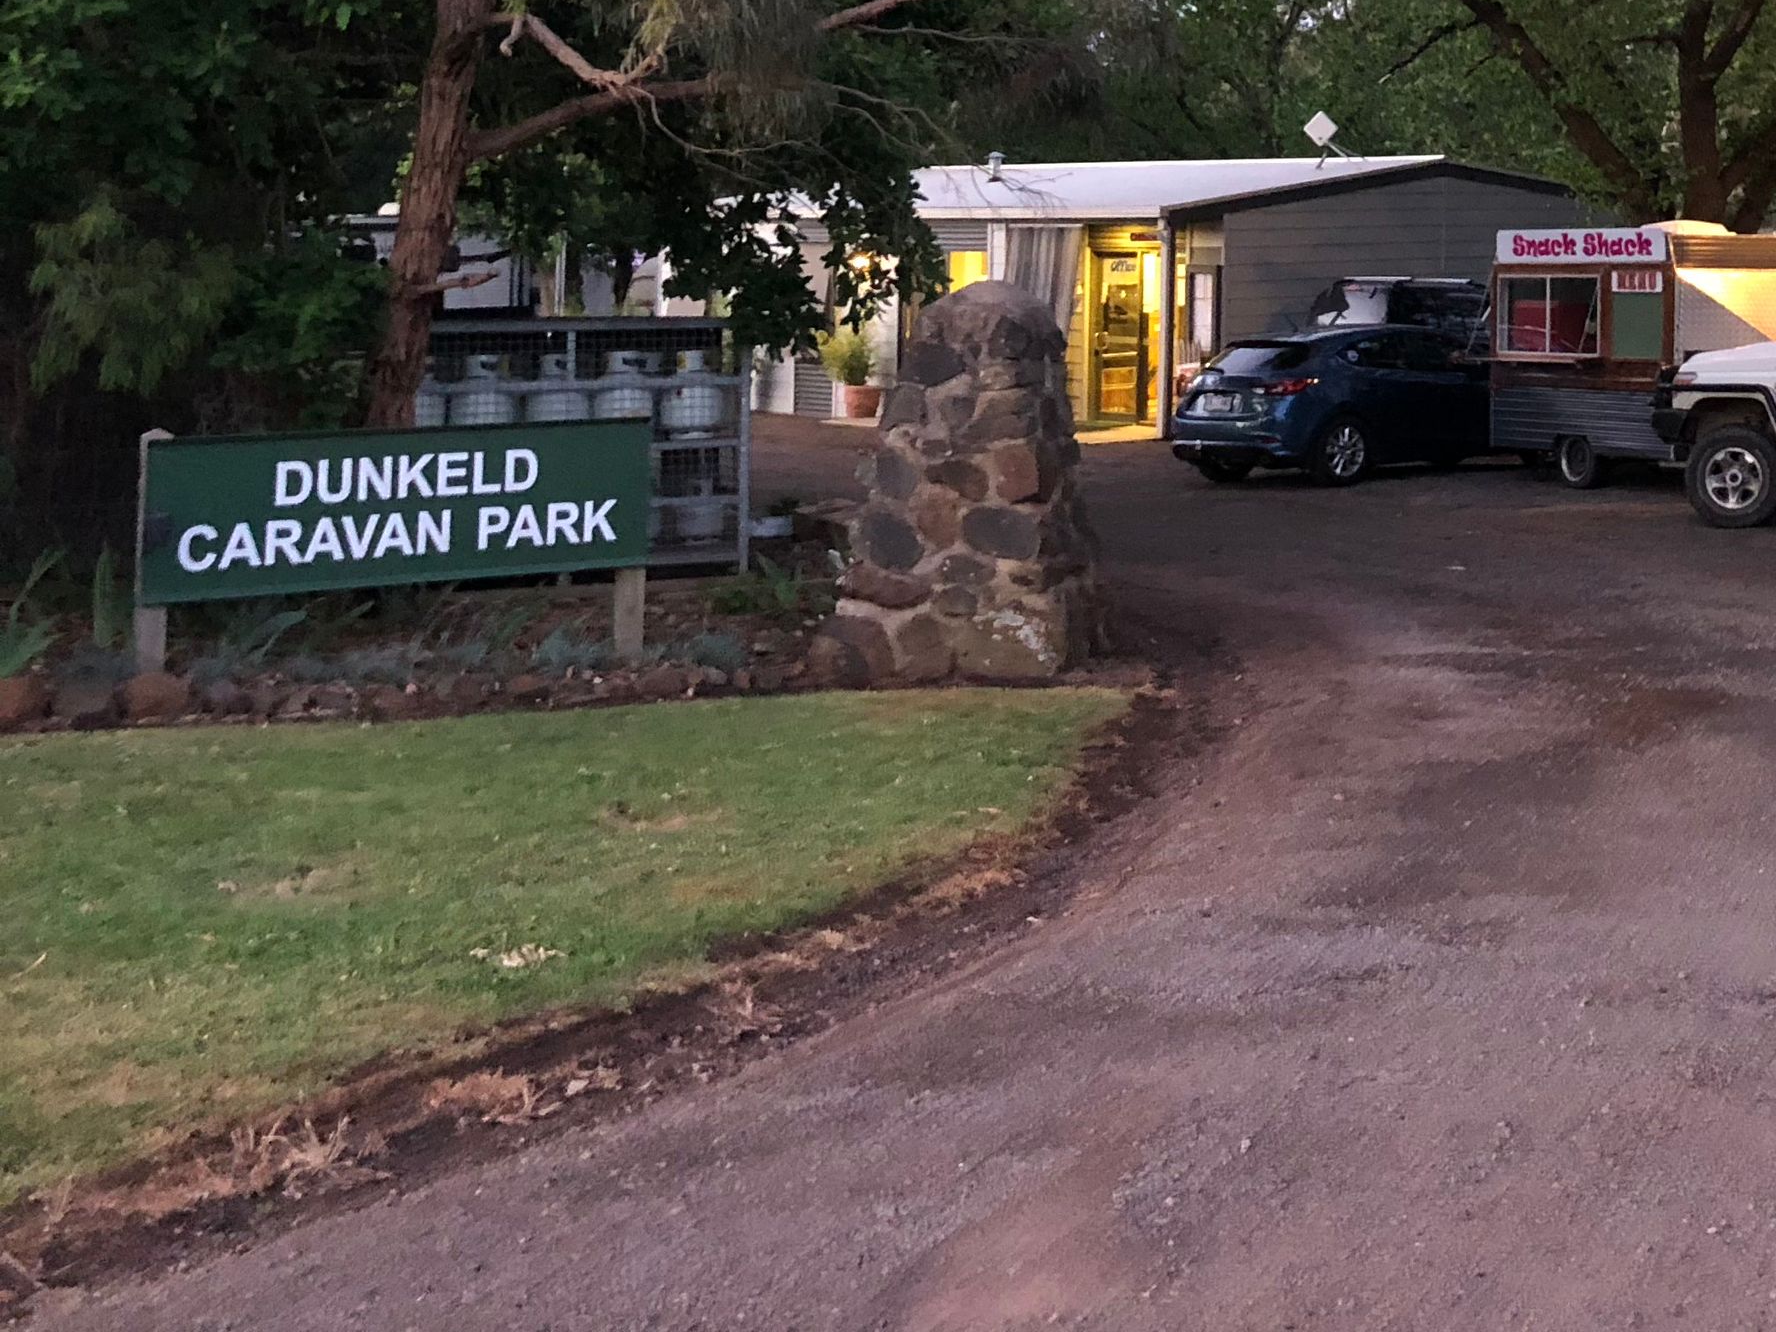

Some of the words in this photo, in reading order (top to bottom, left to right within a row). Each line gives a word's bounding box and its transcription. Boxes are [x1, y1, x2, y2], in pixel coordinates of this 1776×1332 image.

[1512, 232, 1577, 257] Snack
[1583, 232, 1653, 257] Shack
[274, 448, 539, 506] DUNKELD
[177, 508, 452, 572] CARAVAN
[477, 499, 618, 551] PARK
